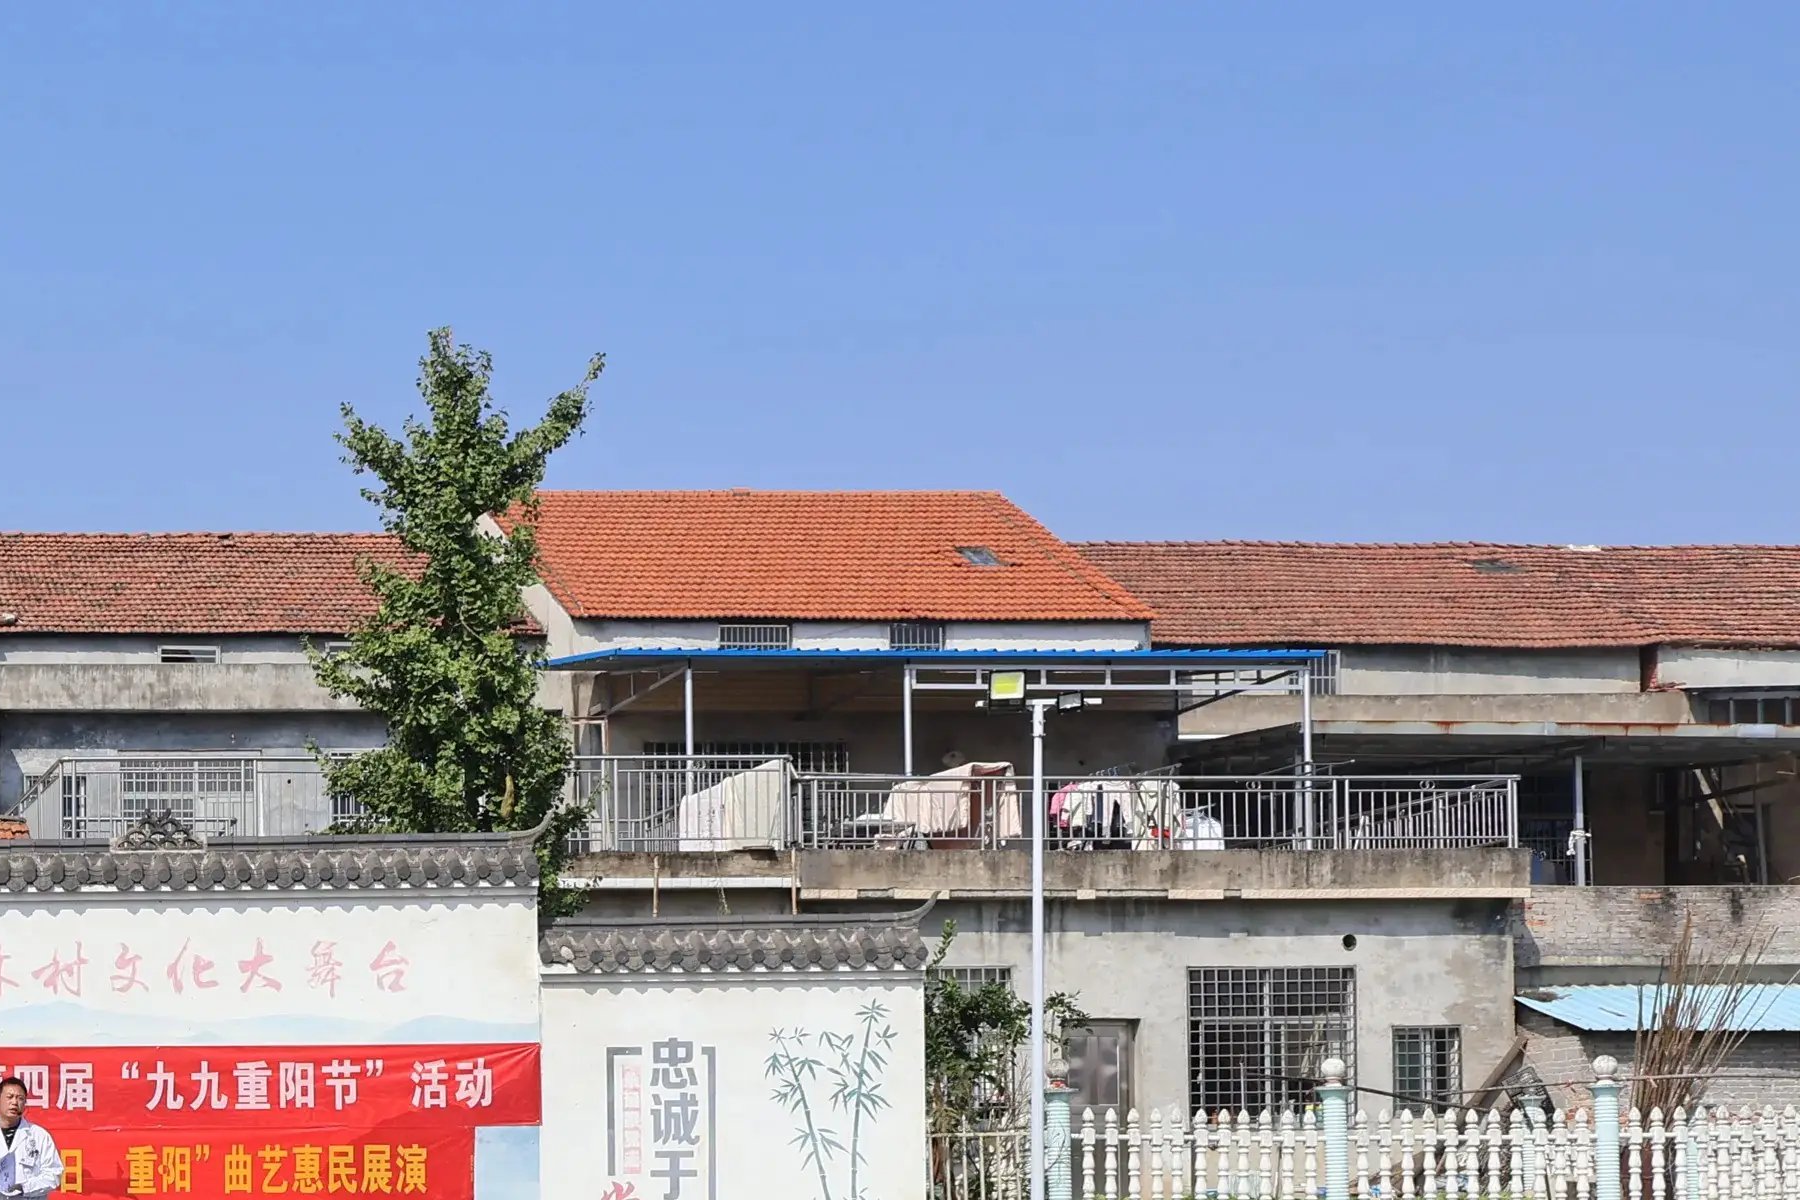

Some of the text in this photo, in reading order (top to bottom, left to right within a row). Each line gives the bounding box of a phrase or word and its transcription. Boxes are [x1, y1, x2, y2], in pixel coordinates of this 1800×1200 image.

[121, 1059, 384, 1111] “九九重阳节”
[411, 1058, 493, 1109] 活动
